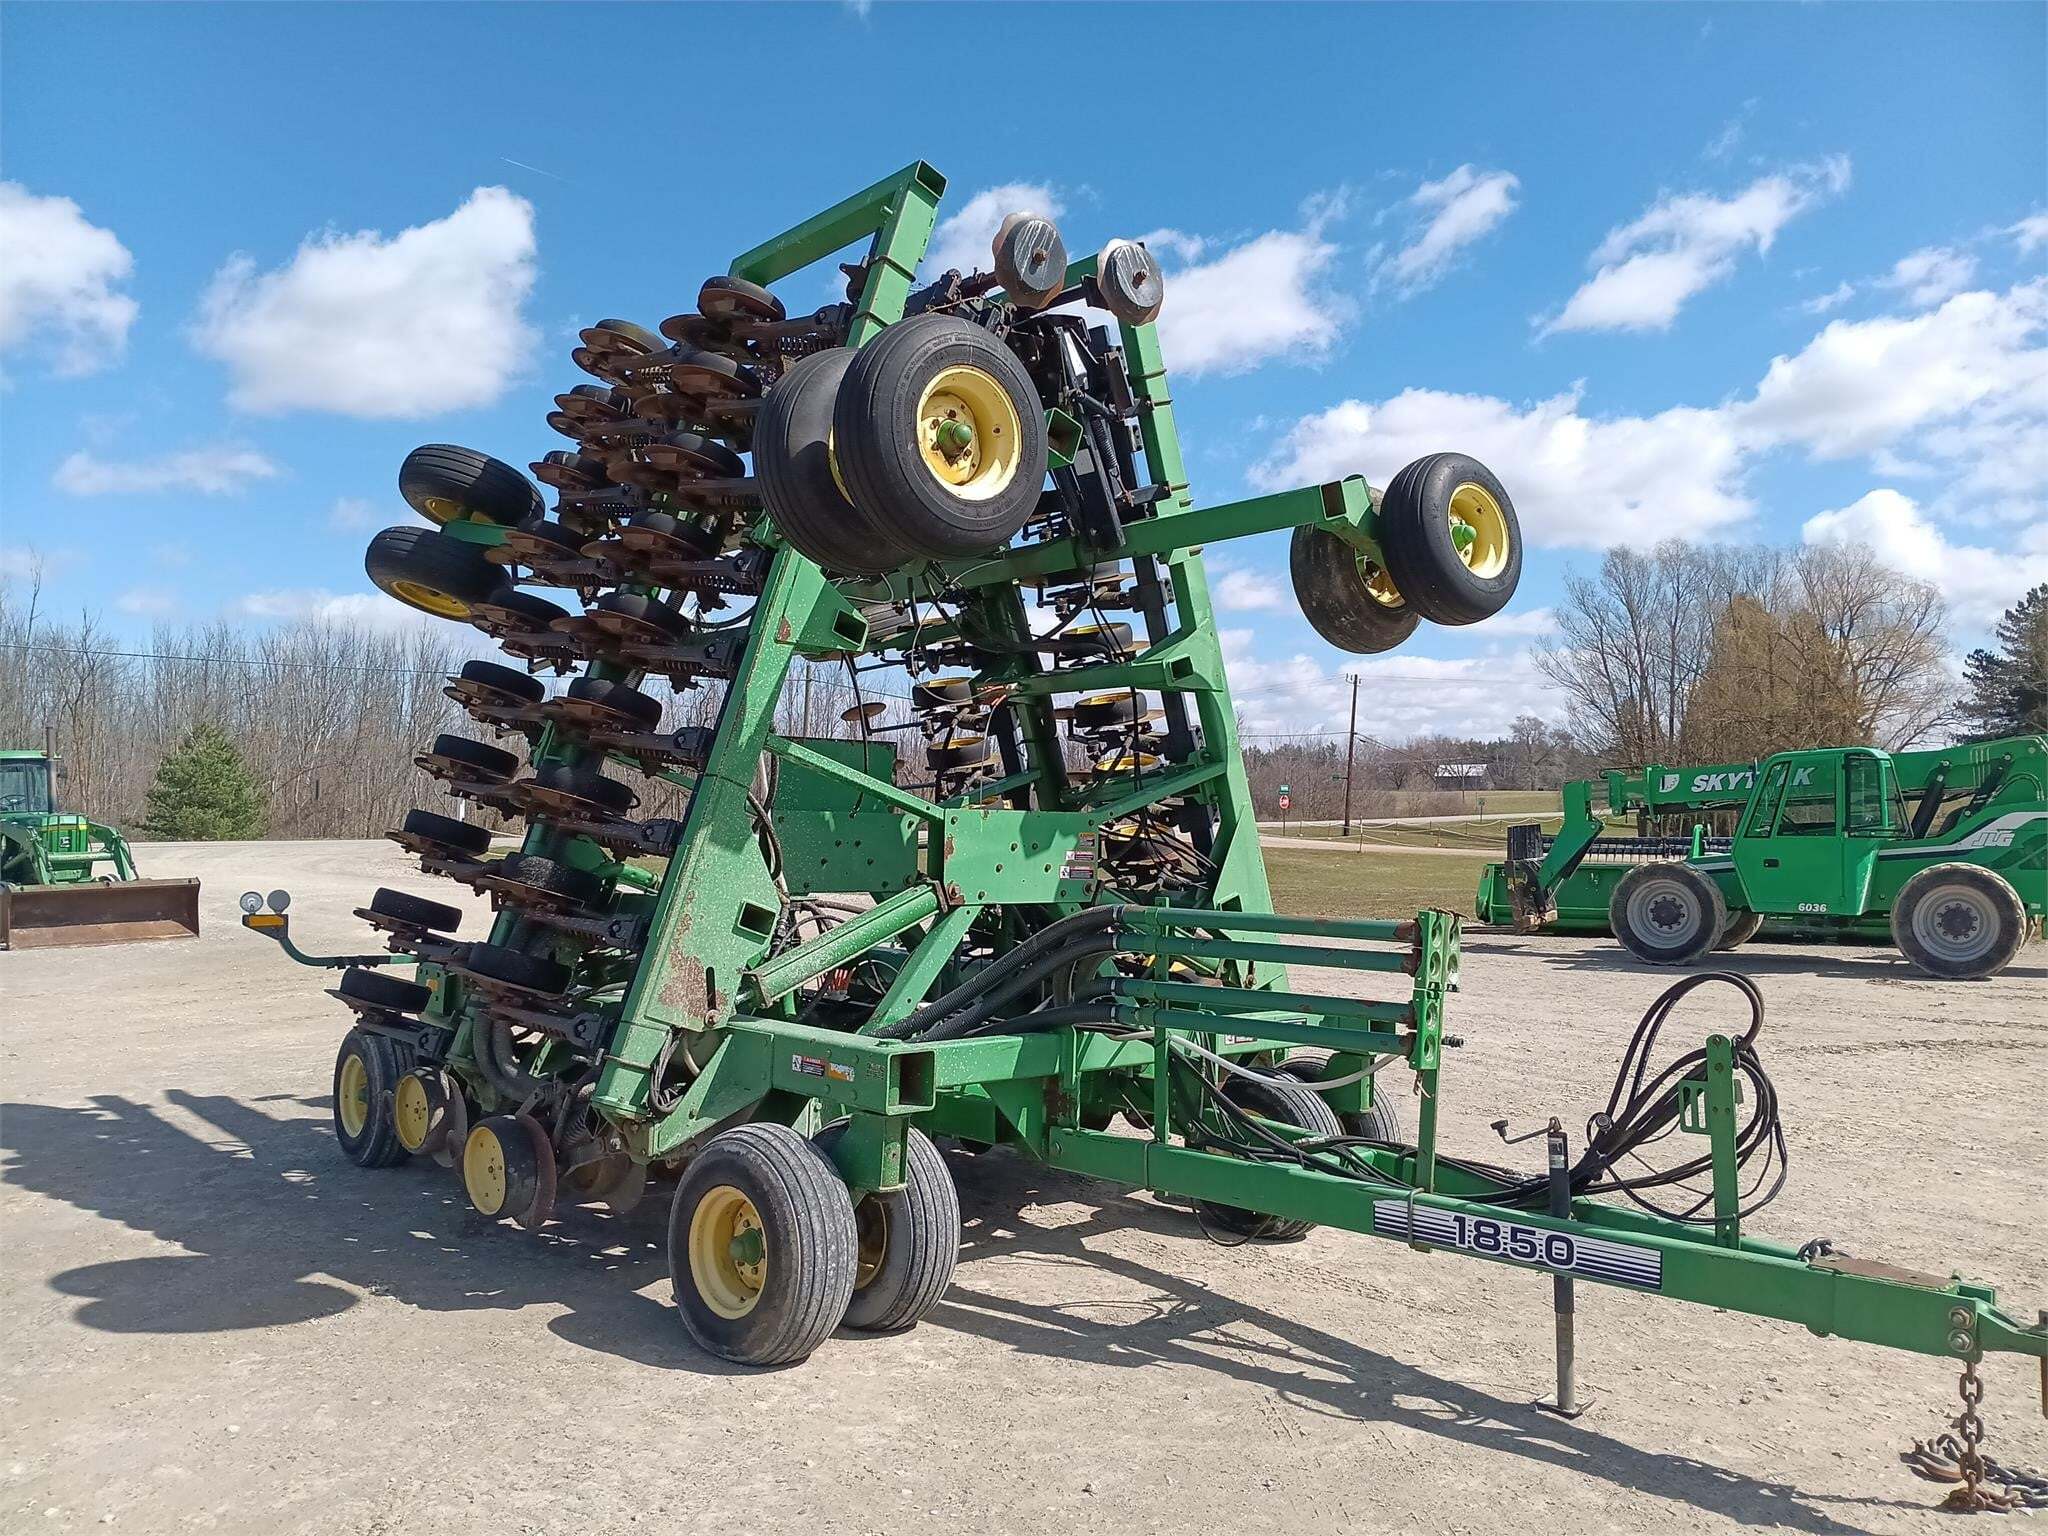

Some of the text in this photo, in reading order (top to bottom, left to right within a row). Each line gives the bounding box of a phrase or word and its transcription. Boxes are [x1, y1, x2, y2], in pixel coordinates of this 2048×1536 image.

[1691, 767, 1816, 793] SKYTK
[1971, 831, 2016, 848] JLG
[1798, 902, 1828, 913] 6036
[1452, 1214, 1576, 1268] 1850
